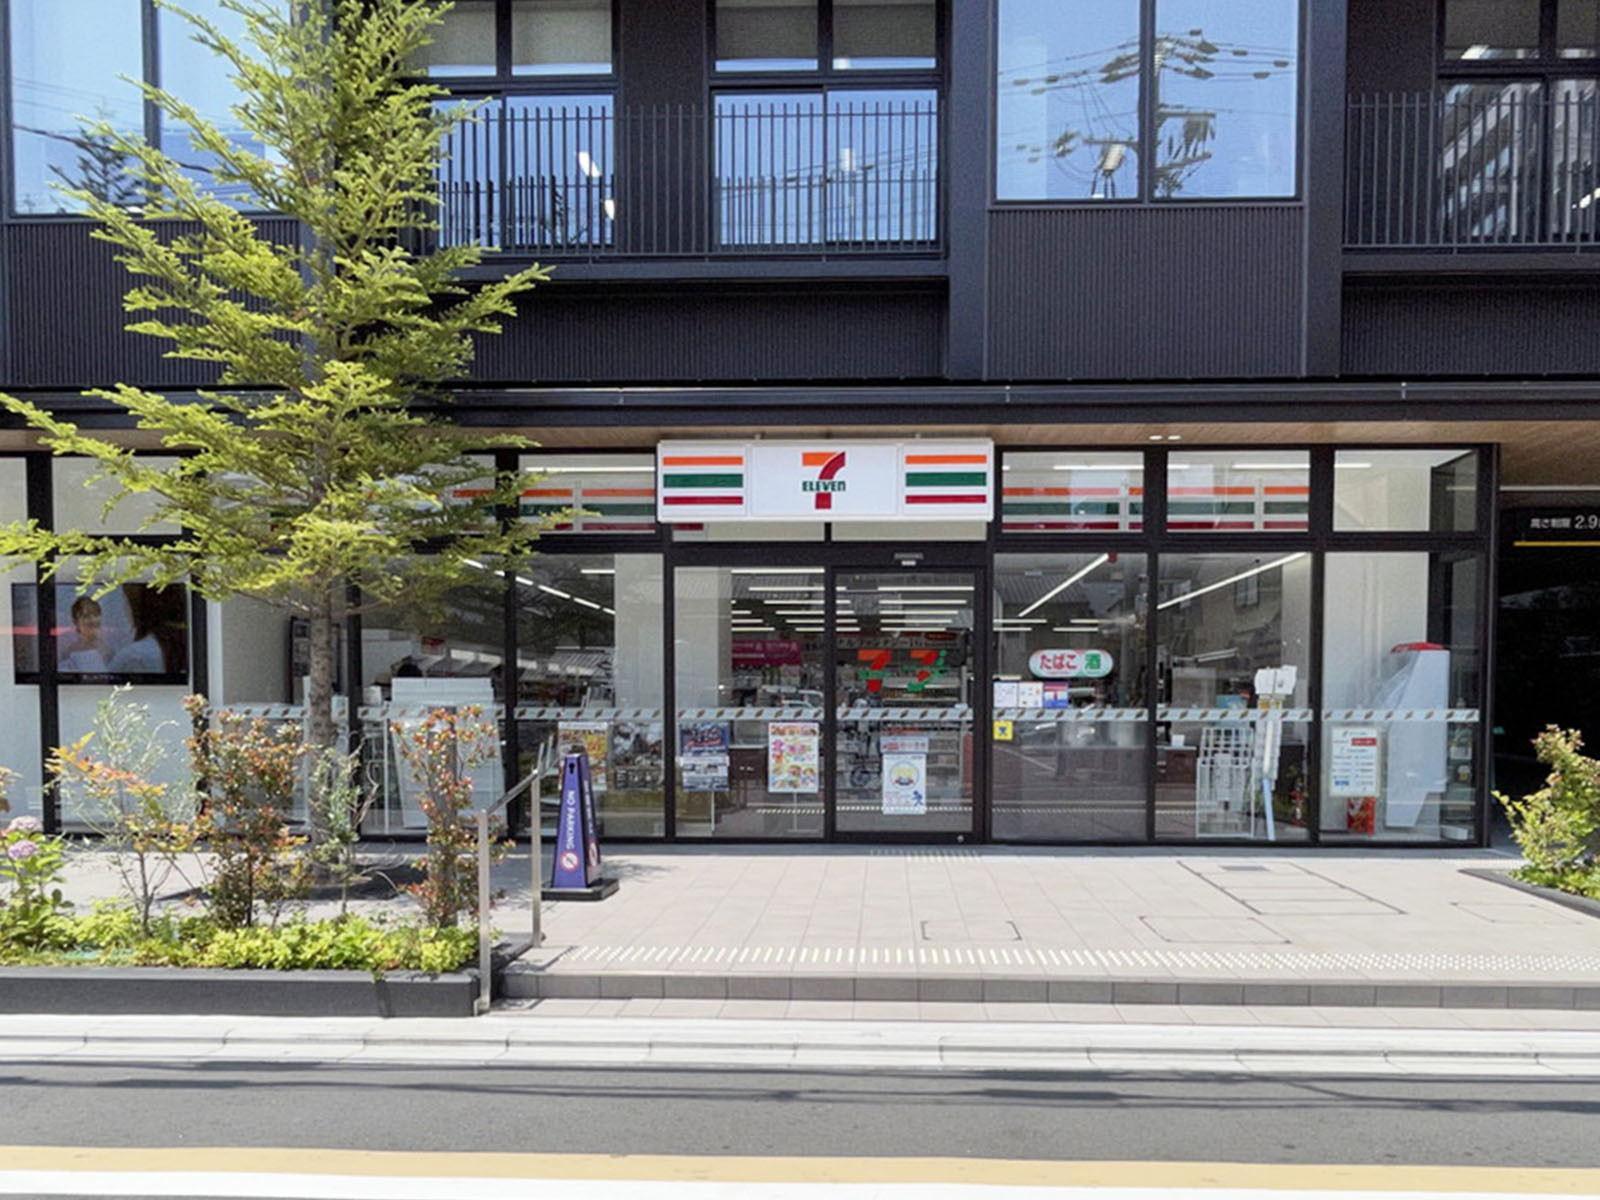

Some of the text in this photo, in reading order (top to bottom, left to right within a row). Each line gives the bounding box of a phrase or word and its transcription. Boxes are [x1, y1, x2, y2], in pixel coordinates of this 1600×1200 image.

[1039, 653, 1102, 670] たばこ 酒
[565, 789, 576, 850] NO PARKING
